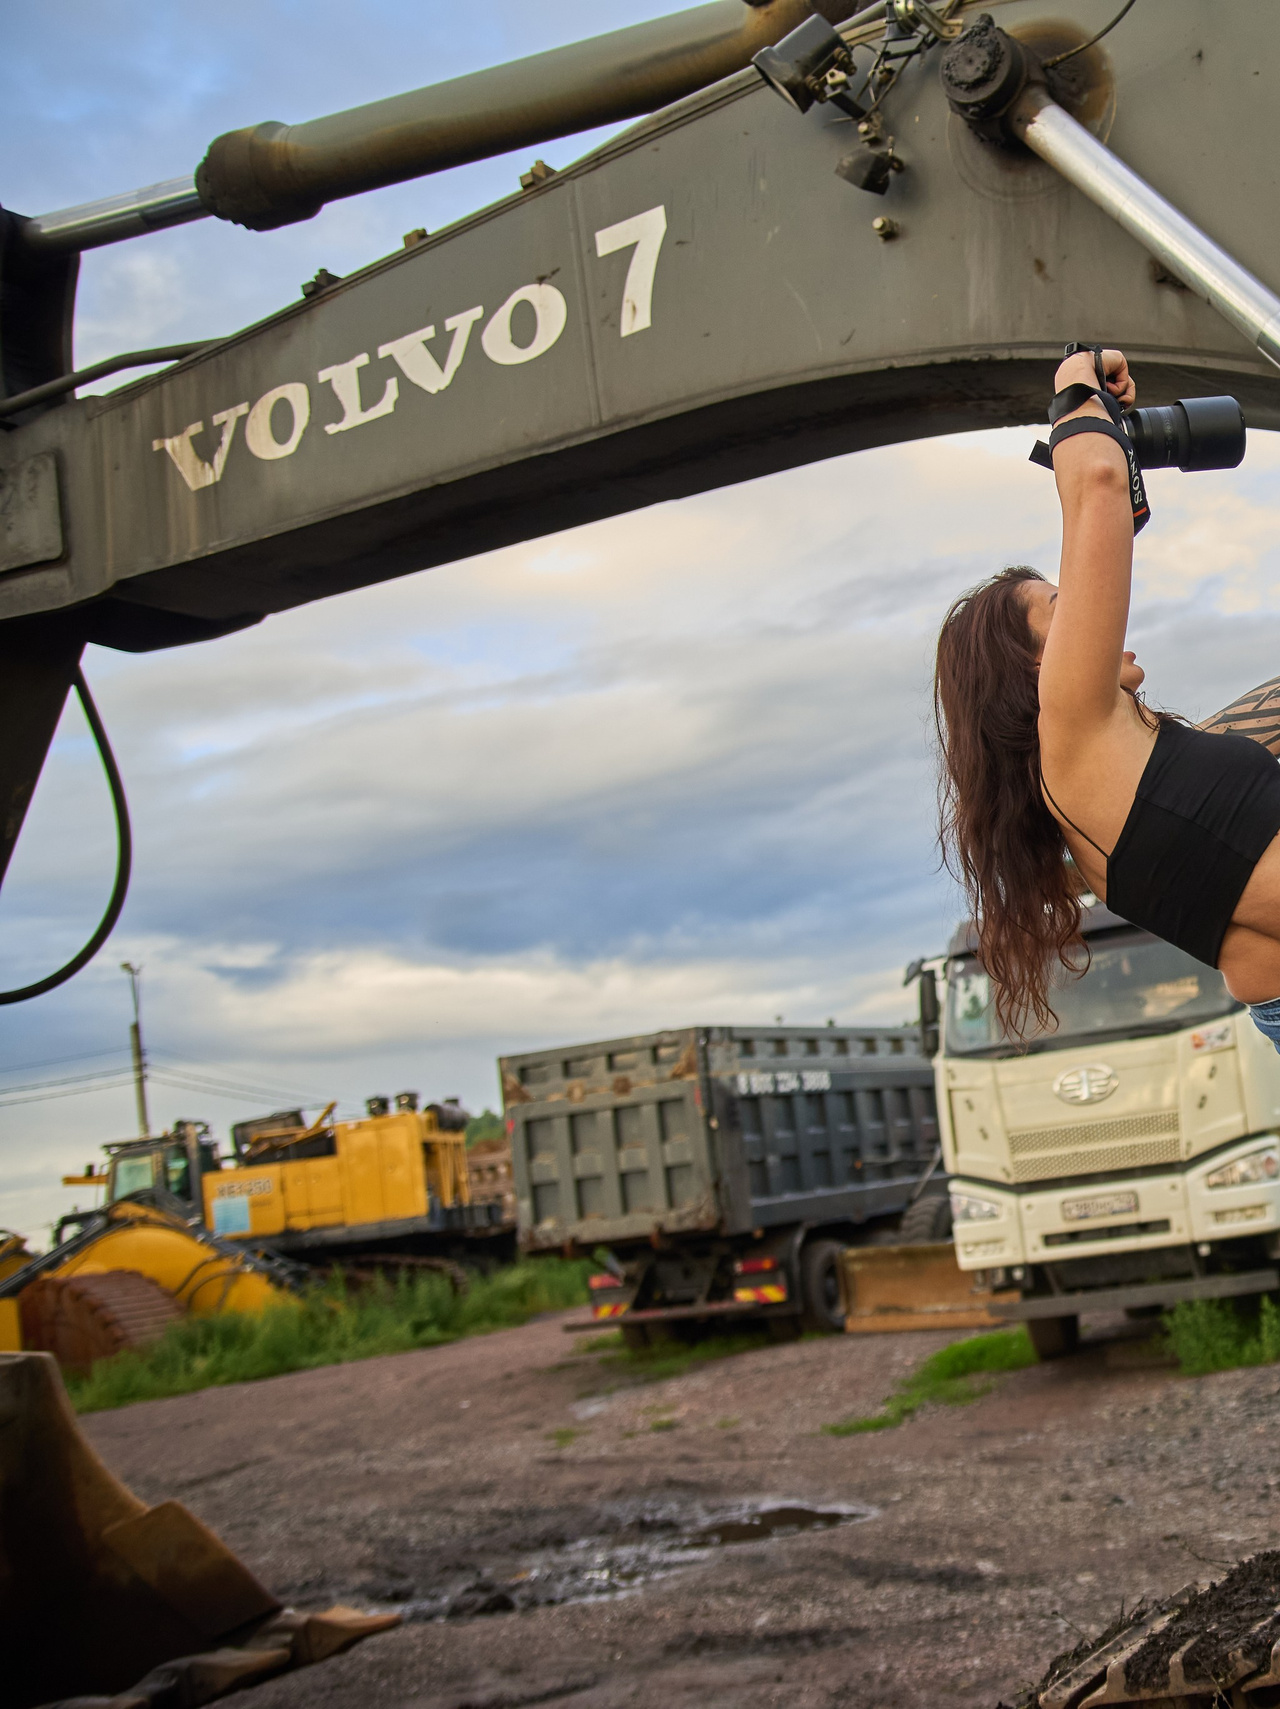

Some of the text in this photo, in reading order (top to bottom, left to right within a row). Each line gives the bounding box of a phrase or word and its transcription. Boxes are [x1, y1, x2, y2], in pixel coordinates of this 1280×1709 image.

[153, 205, 667, 491] VOLVO 7
[1128, 448, 1143, 504] SONY
